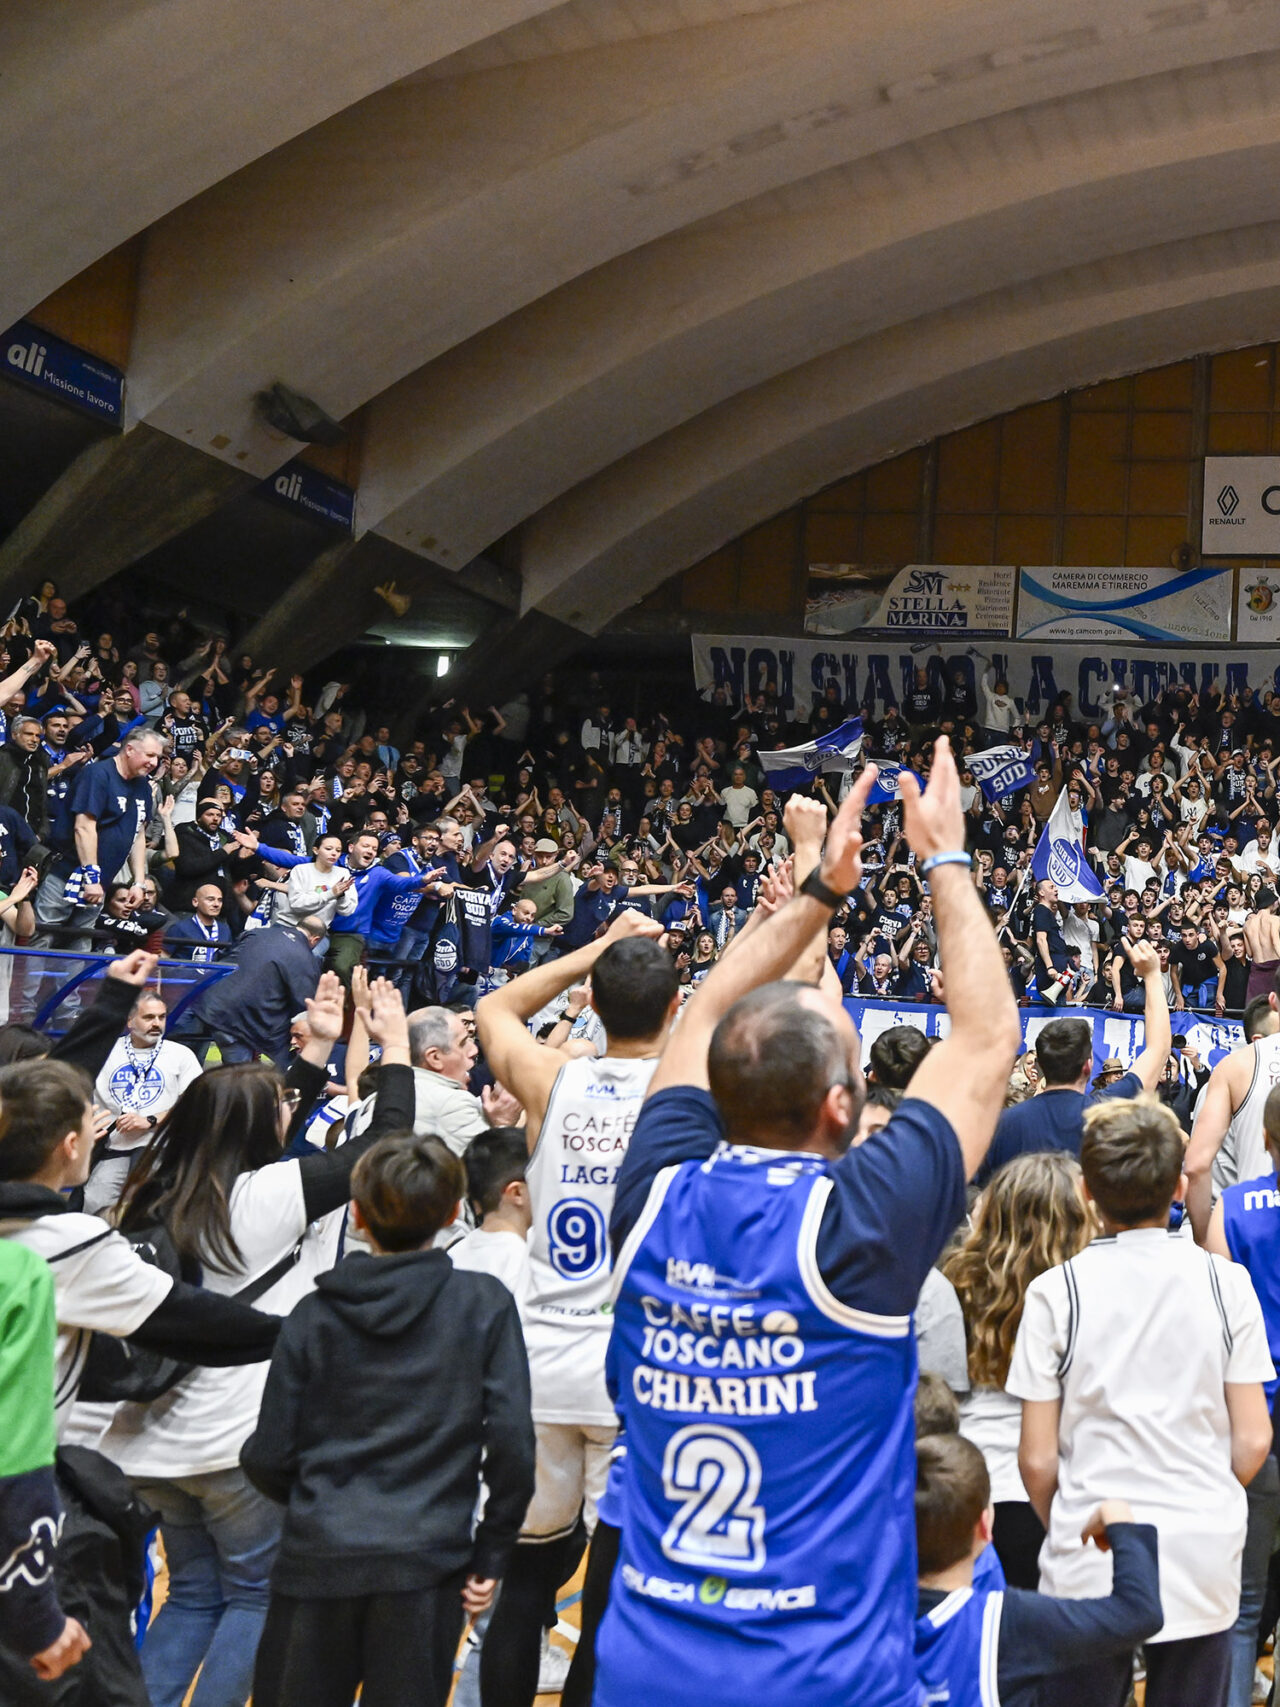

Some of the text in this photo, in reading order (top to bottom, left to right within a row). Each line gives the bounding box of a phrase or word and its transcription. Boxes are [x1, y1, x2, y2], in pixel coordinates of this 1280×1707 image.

[7, 342, 47, 377] ali
[44, 370, 84, 398] Missione
[275, 473, 303, 500] ali
[1052, 573, 1086, 581] CAMERA
[1087, 573, 1096, 581] DI
[1052, 582, 1100, 590] MAREMMA
[1109, 582, 1148, 590] TIRRENO
[889, 598, 966, 610] STELLA
[888, 612, 966, 625] MARINA
[710, 647, 795, 722] NOI
[992, 762, 1027, 792] SUD
[1054, 840, 1077, 873] CURVA
[1051, 859, 1067, 883] SUD
[456, 890, 493, 906] CURVA
[465, 901, 486, 916] SUD
[116, 1070, 158, 1080] CUA
[585, 1084, 616, 1097] HVM
[547, 1197, 606, 1281] 9
[641, 1326, 805, 1370] TOSCANO
[633, 1366, 818, 1416] CHIARINI
[661, 1423, 767, 1572] 2
